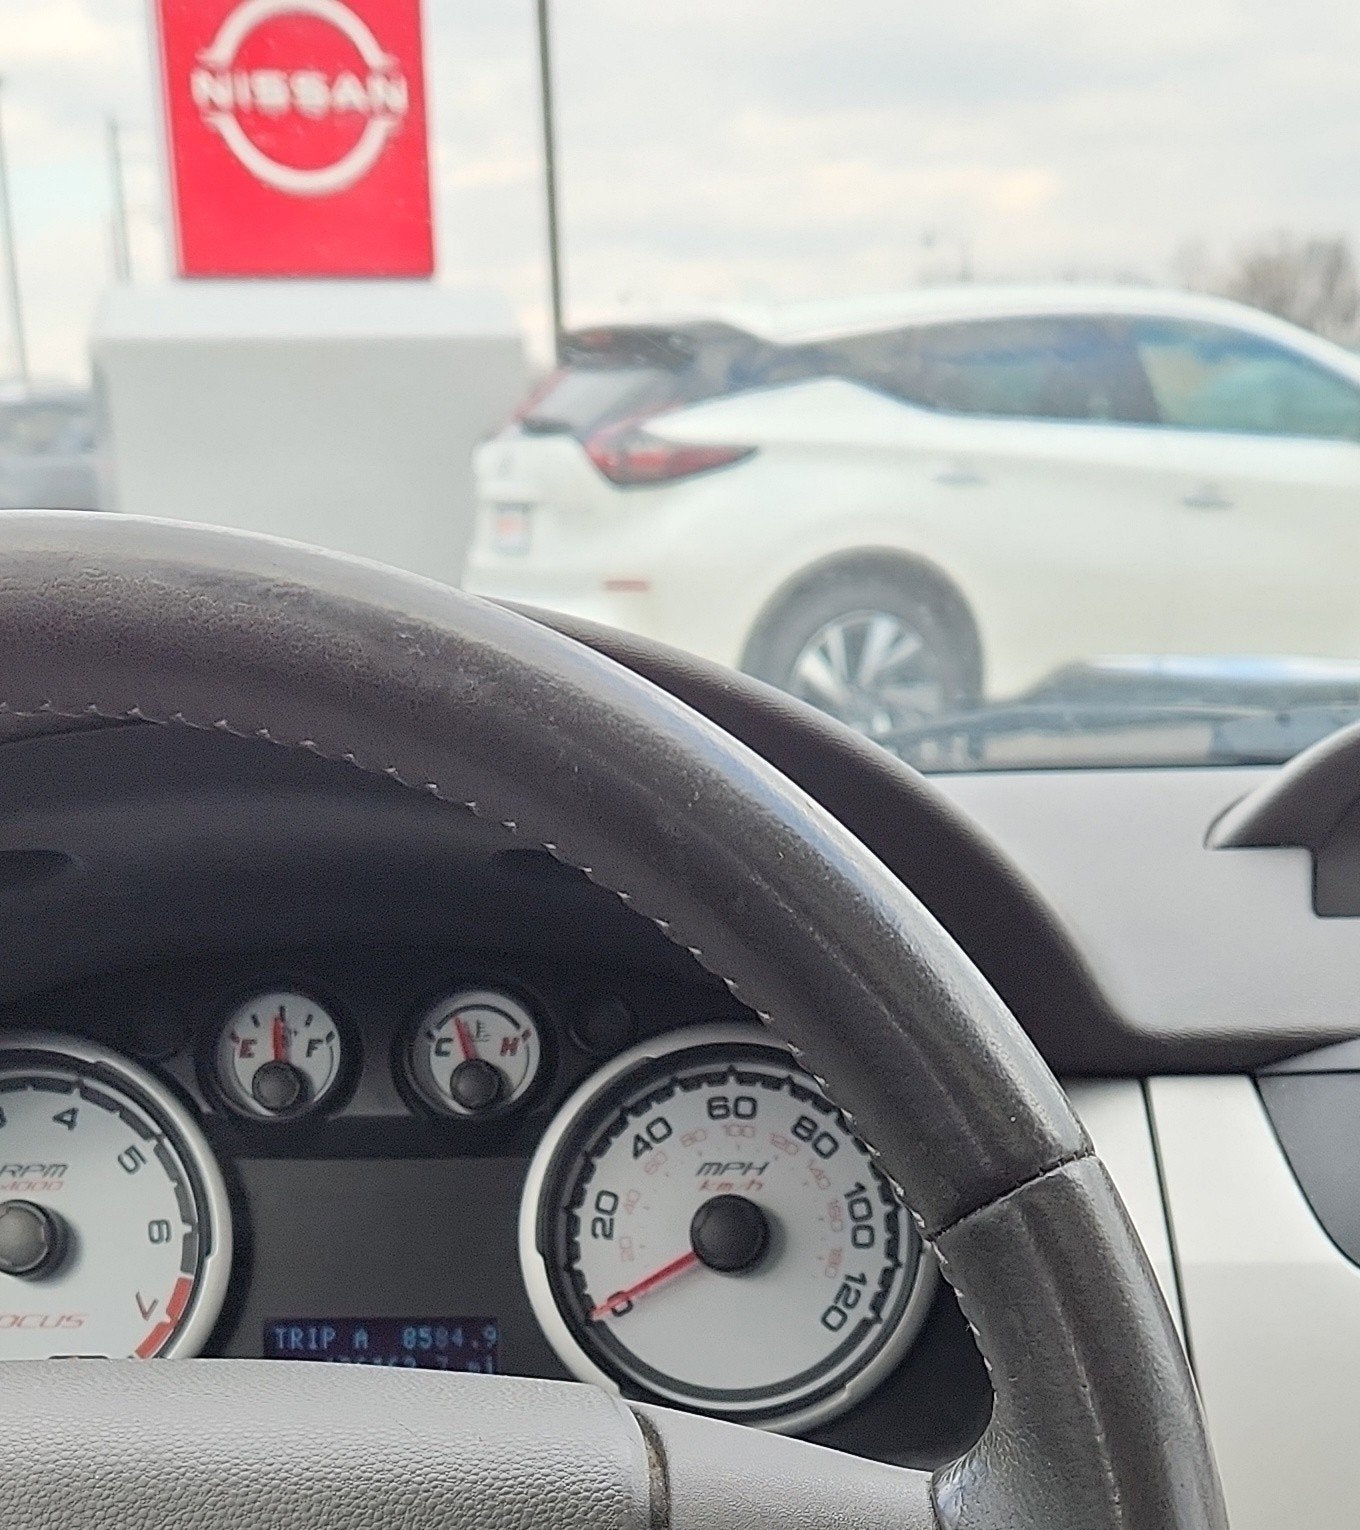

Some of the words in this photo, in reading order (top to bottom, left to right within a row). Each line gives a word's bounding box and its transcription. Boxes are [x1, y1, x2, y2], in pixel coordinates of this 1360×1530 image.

[190, 67, 409, 120] NISSAN
[240, 1039, 257, 1058] E
[306, 1039, 323, 1057] F
[435, 1038, 453, 1056] C
[501, 1037, 519, 1056] H
[53, 1107, 80, 1131] 4
[707, 1095, 758, 1121] 60
[632, 1116, 673, 1159] 40
[790, 1115, 839, 1159] 80
[117, 1145, 146, 1174] 5
[695, 1161, 770, 1176] MPH
[591, 1189, 619, 1241] 20
[844, 1181, 876, 1250] 100
[148, 1218, 172, 1245] 6
[135, 1290, 159, 1320] 7
[607, 1290, 634, 1317] 0
[821, 1272, 868, 1332] 120
[274, 1327, 336, 1349] TRIP
[353, 1327, 369, 1349] A
